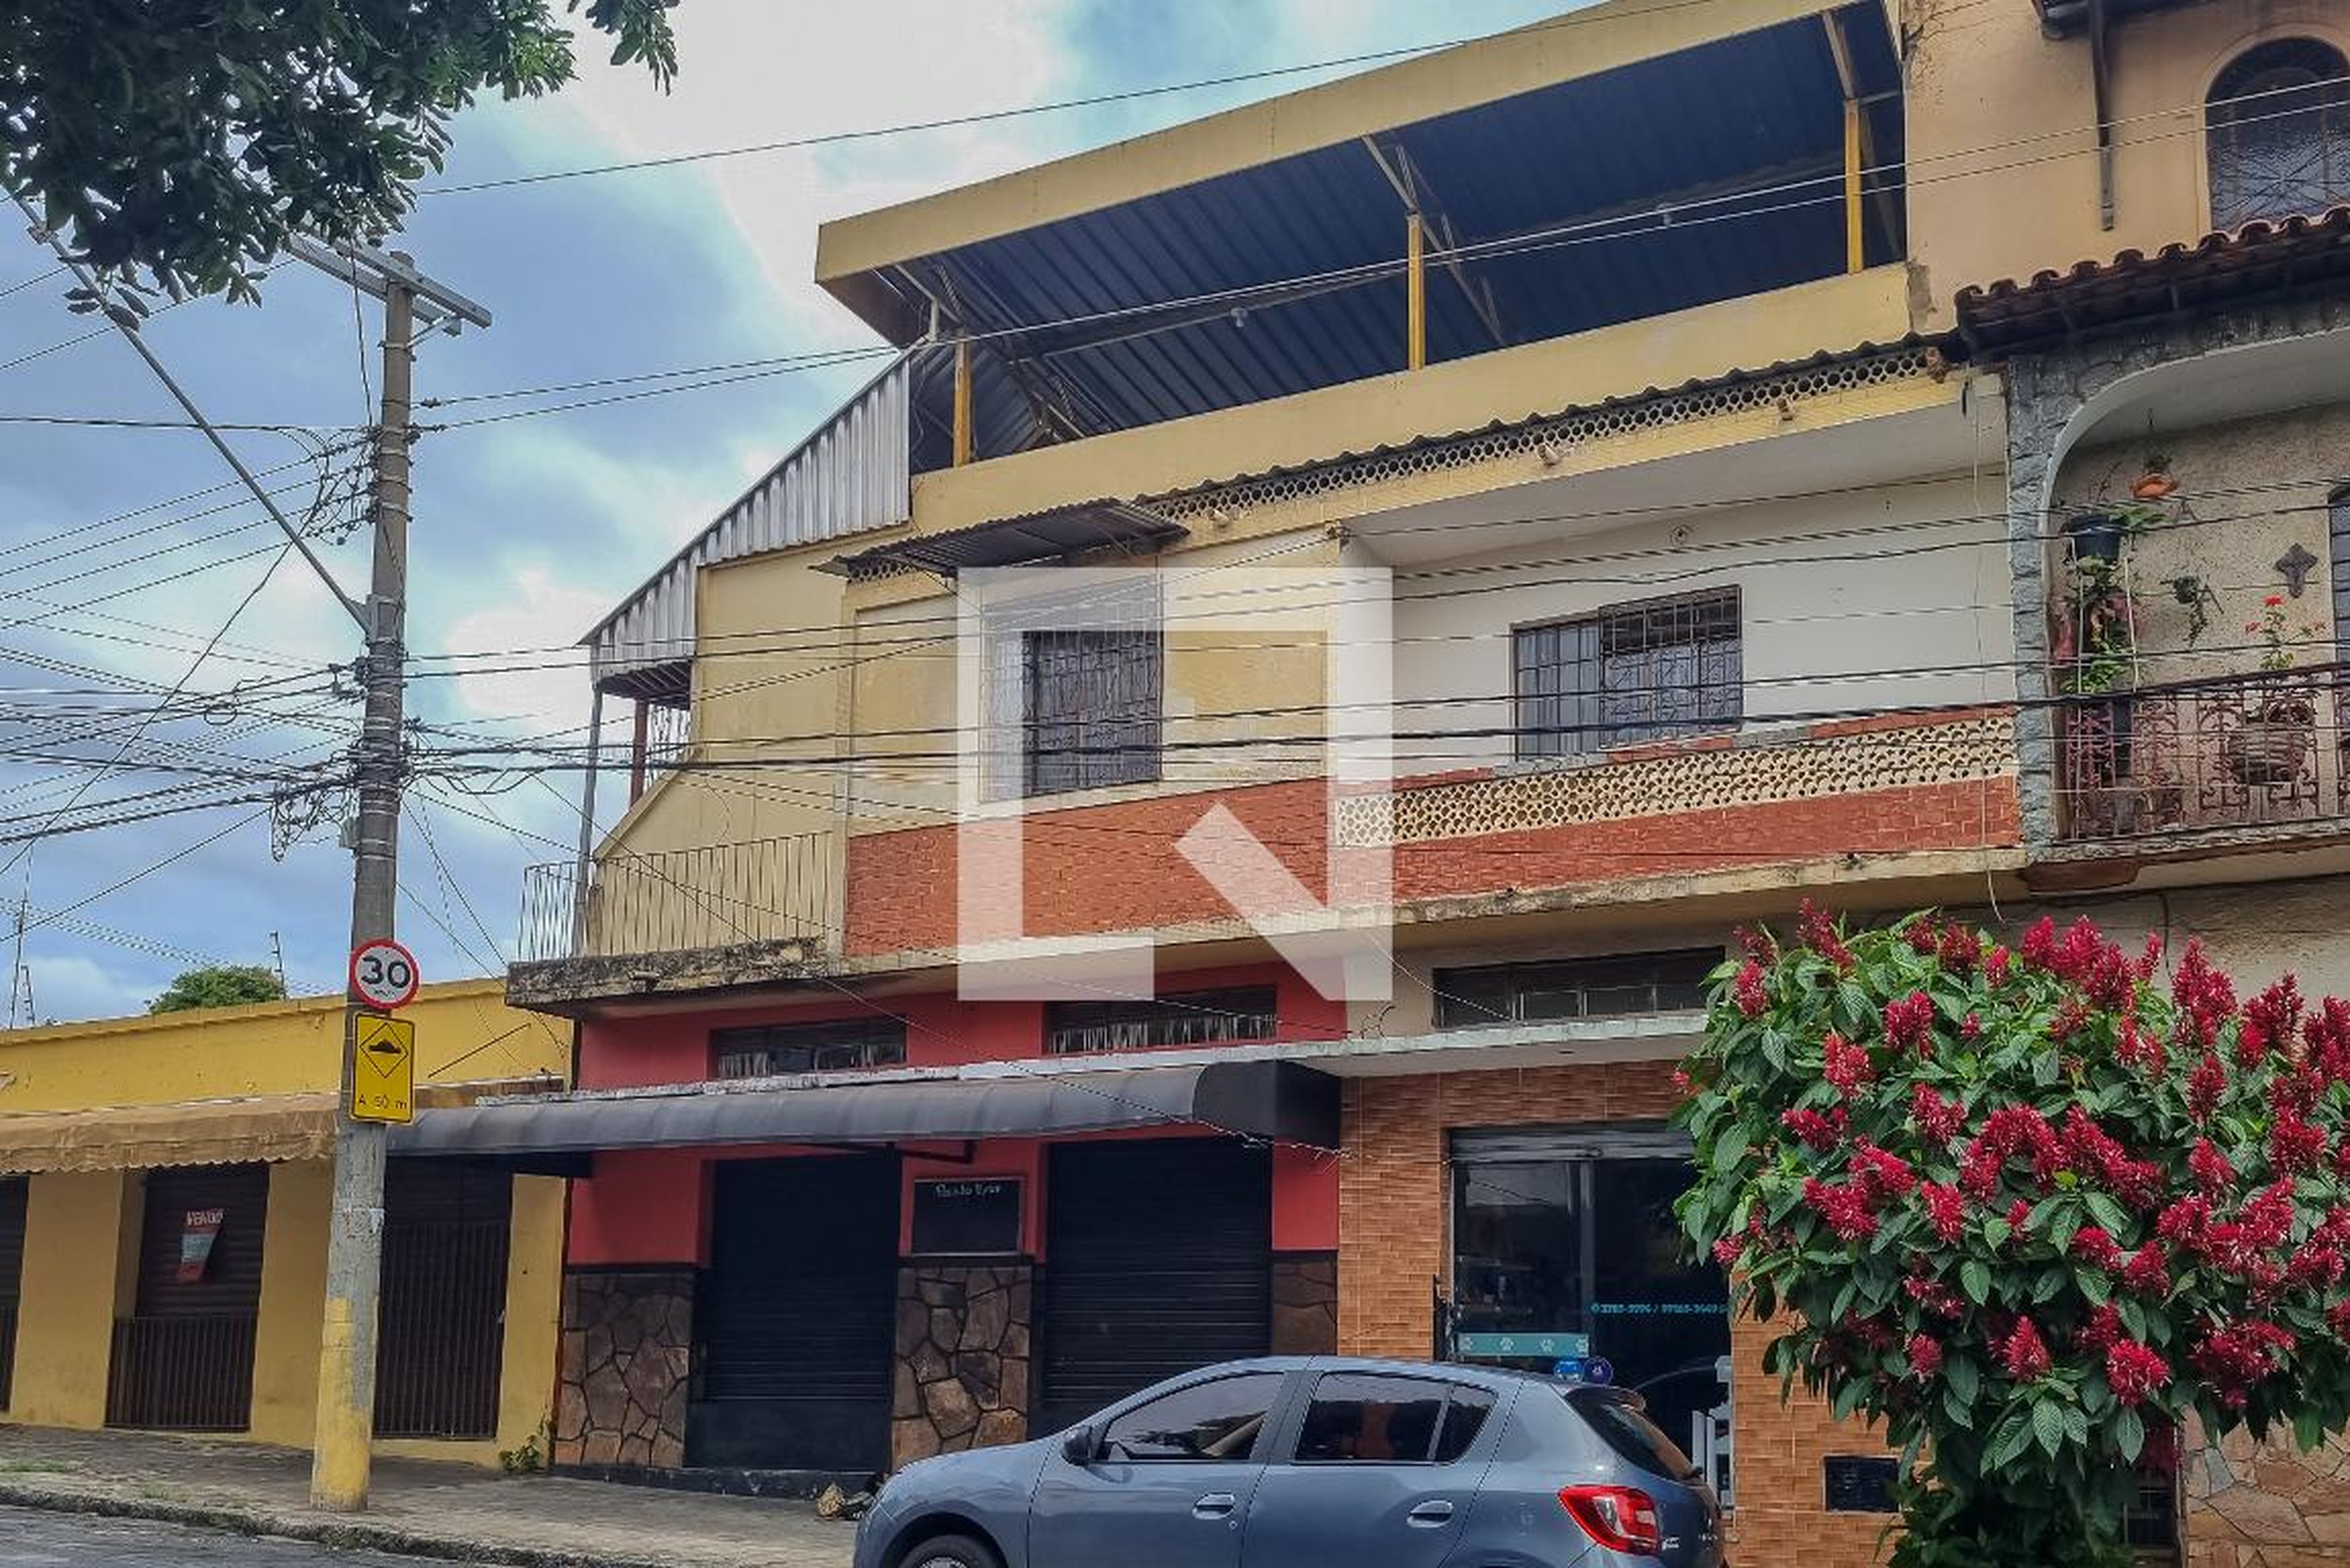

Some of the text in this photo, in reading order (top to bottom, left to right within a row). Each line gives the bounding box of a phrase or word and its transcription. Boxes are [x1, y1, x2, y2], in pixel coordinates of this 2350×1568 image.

[361, 955, 411, 988] 30
[359, 1093, 366, 1105] A
[394, 1100, 407, 1109] m
